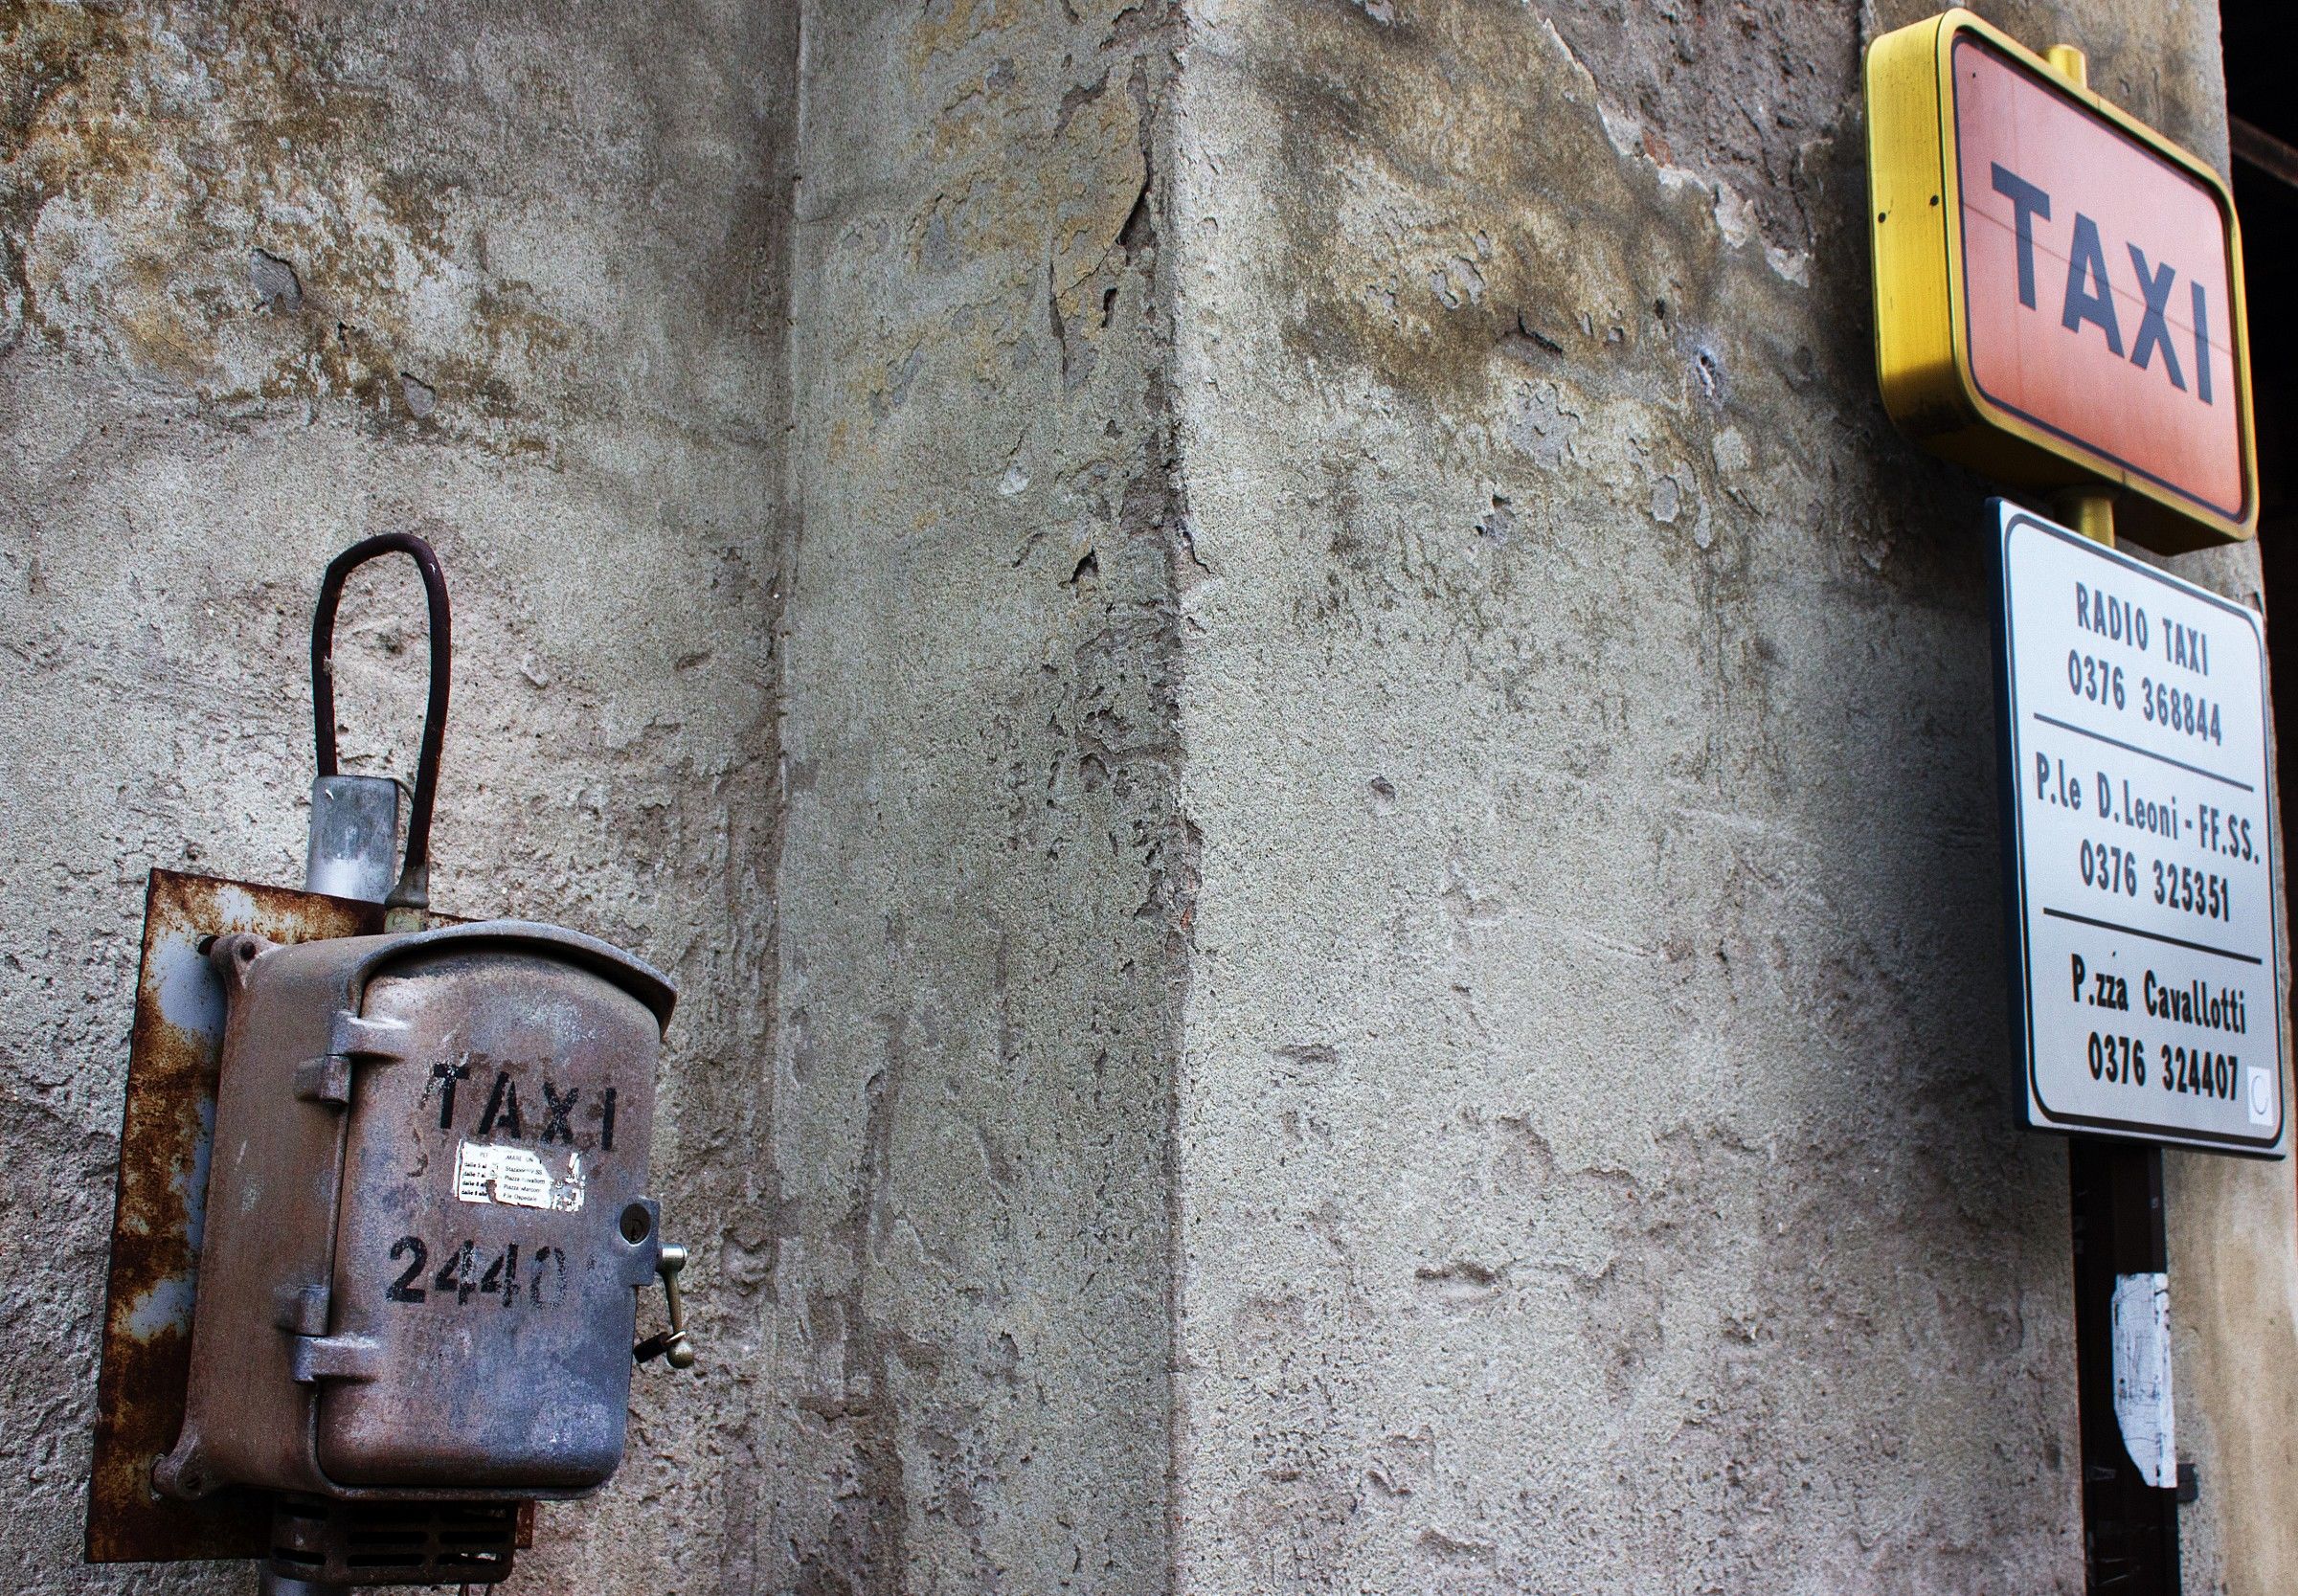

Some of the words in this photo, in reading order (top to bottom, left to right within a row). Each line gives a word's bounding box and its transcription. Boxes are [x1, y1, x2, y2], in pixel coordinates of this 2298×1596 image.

[1991, 161, 2213, 406] TAXI
[2075, 581, 2149, 651] RADIO
[2162, 618, 2208, 676] TAXI
[2068, 649, 2126, 710] 0376
[2141, 677, 2221, 746] 368844
[2036, 751, 2082, 810] P.le
[2081, 839, 2136, 897] 0376
[2152, 860, 2229, 922] 325351
[2071, 954, 2129, 1011] P.zza
[2144, 969, 2246, 1034] Cavallotti
[434, 1063, 617, 1150] TAXI
[2087, 1031, 2146, 1087] 0376
[2161, 1044, 2239, 1101] 324407
